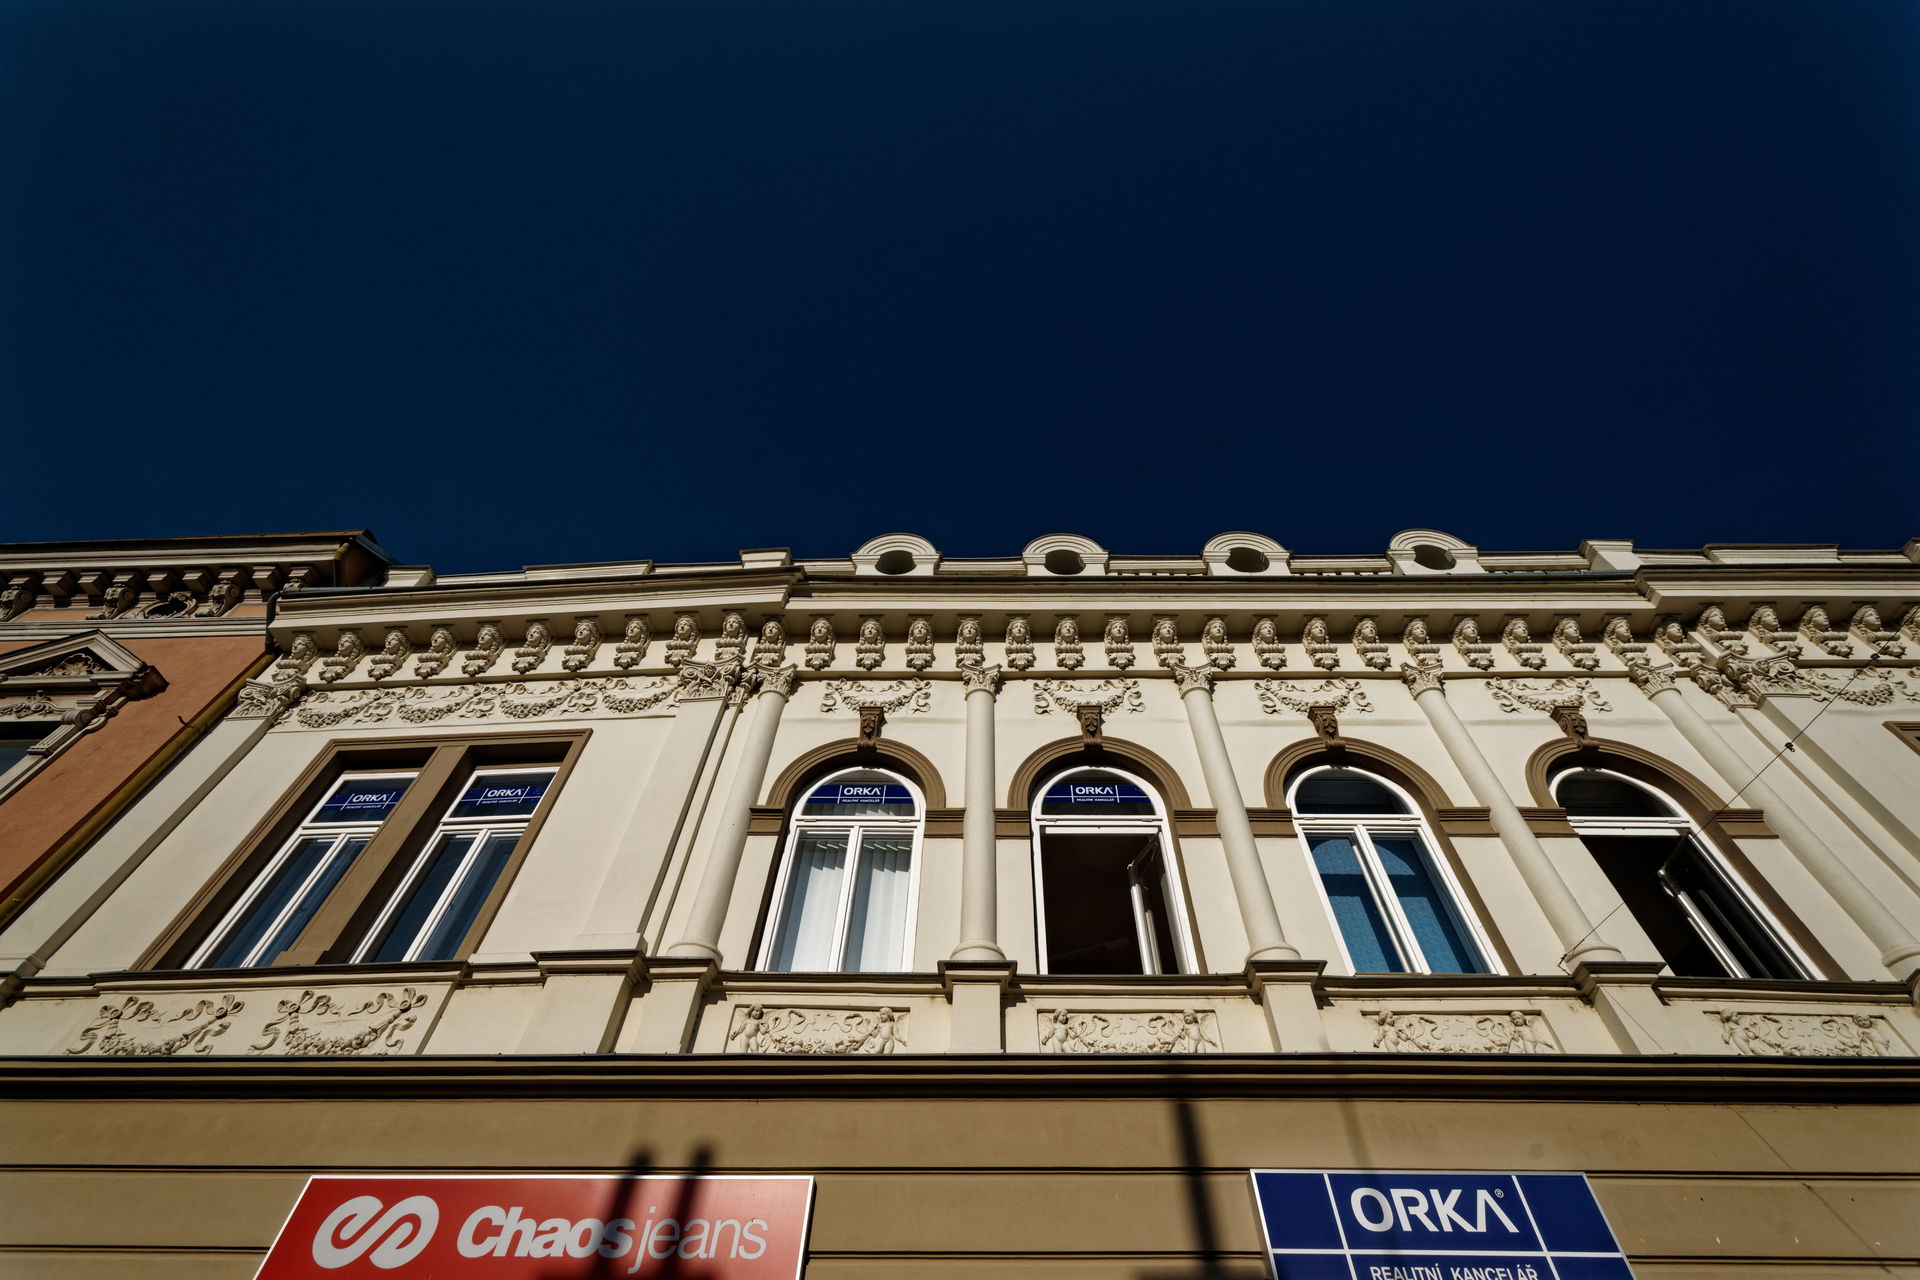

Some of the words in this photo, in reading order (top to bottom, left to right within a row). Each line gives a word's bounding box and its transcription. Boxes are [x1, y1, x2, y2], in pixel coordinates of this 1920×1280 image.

[487, 789, 522, 797] ORKA
[843, 787, 881, 796] ORKA
[1075, 786, 1114, 795] ORKA
[352, 794, 387, 802] ORKA
[1350, 1187, 1520, 1233] ORKA
